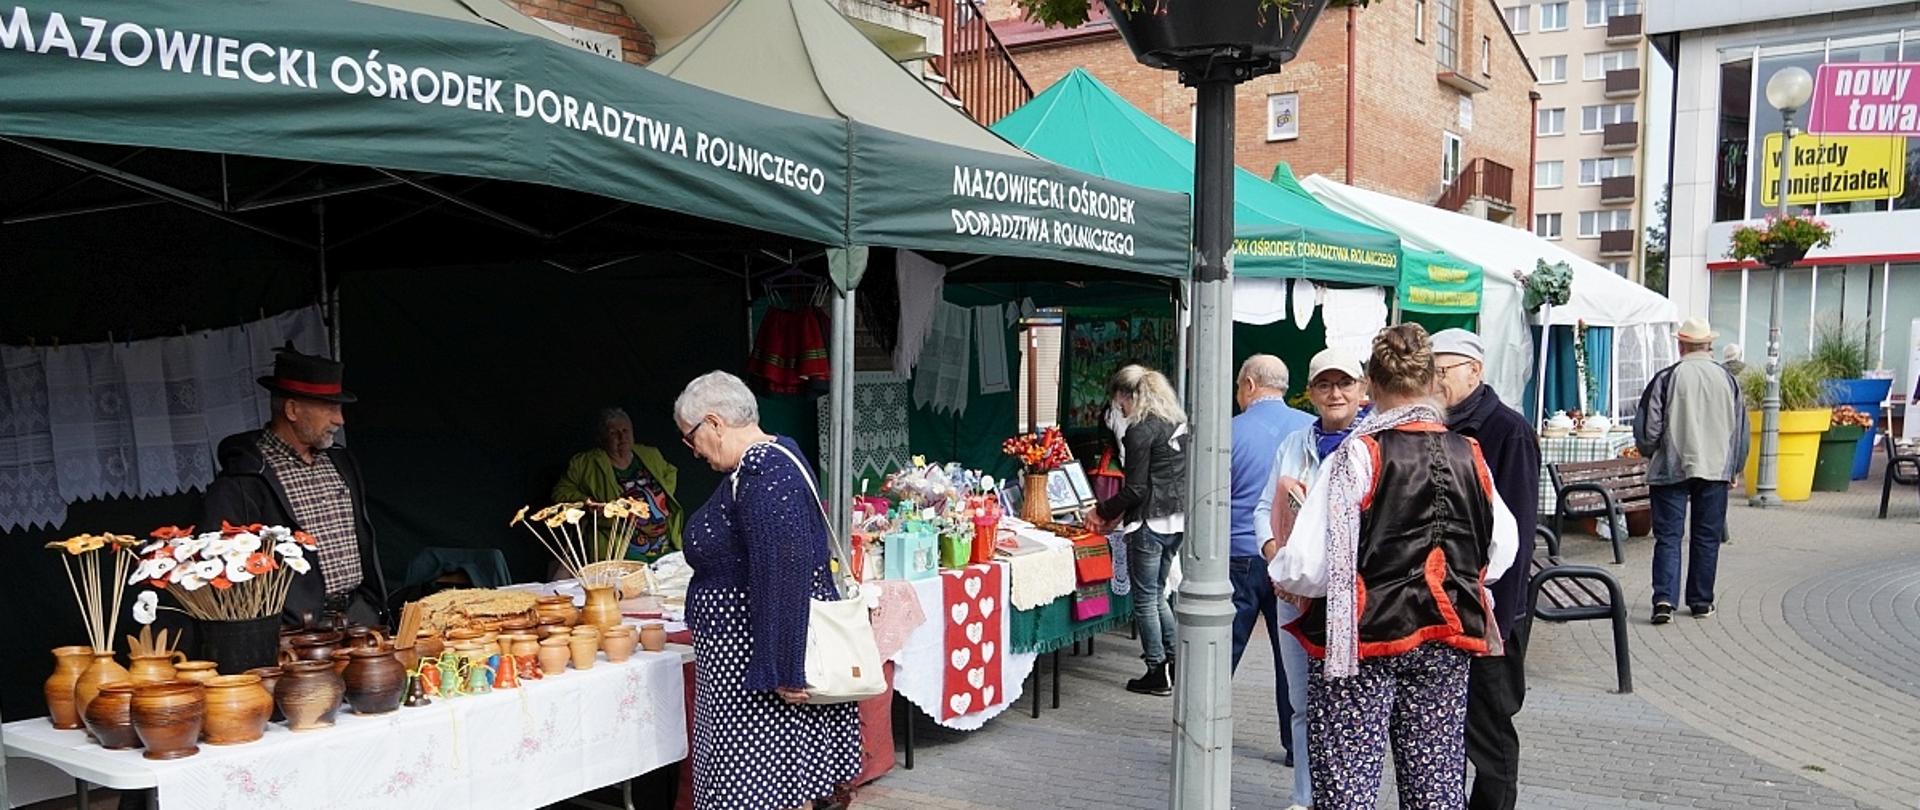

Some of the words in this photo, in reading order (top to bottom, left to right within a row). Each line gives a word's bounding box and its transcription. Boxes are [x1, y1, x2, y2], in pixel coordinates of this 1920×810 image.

[0, 6, 319, 89] MAZOWIECKI
[331, 49, 504, 114] OŚRODEK
[515, 83, 688, 158] DORADZTWA
[695, 131, 825, 195] ROLNICZEGO
[1835, 68, 1911, 101] nowy
[1848, 98, 1920, 131] towa
[1794, 142, 1848, 167] każdy
[953, 165, 1064, 210] MAZOWIECKI
[1068, 181, 1135, 225] OŚRODEK
[951, 208, 1049, 243] DORADZTWA
[1053, 219, 1135, 256] ROLNICZEGO
[1250, 237, 1297, 257] OŚRODEK
[1298, 242, 1350, 262] DORADZTWA
